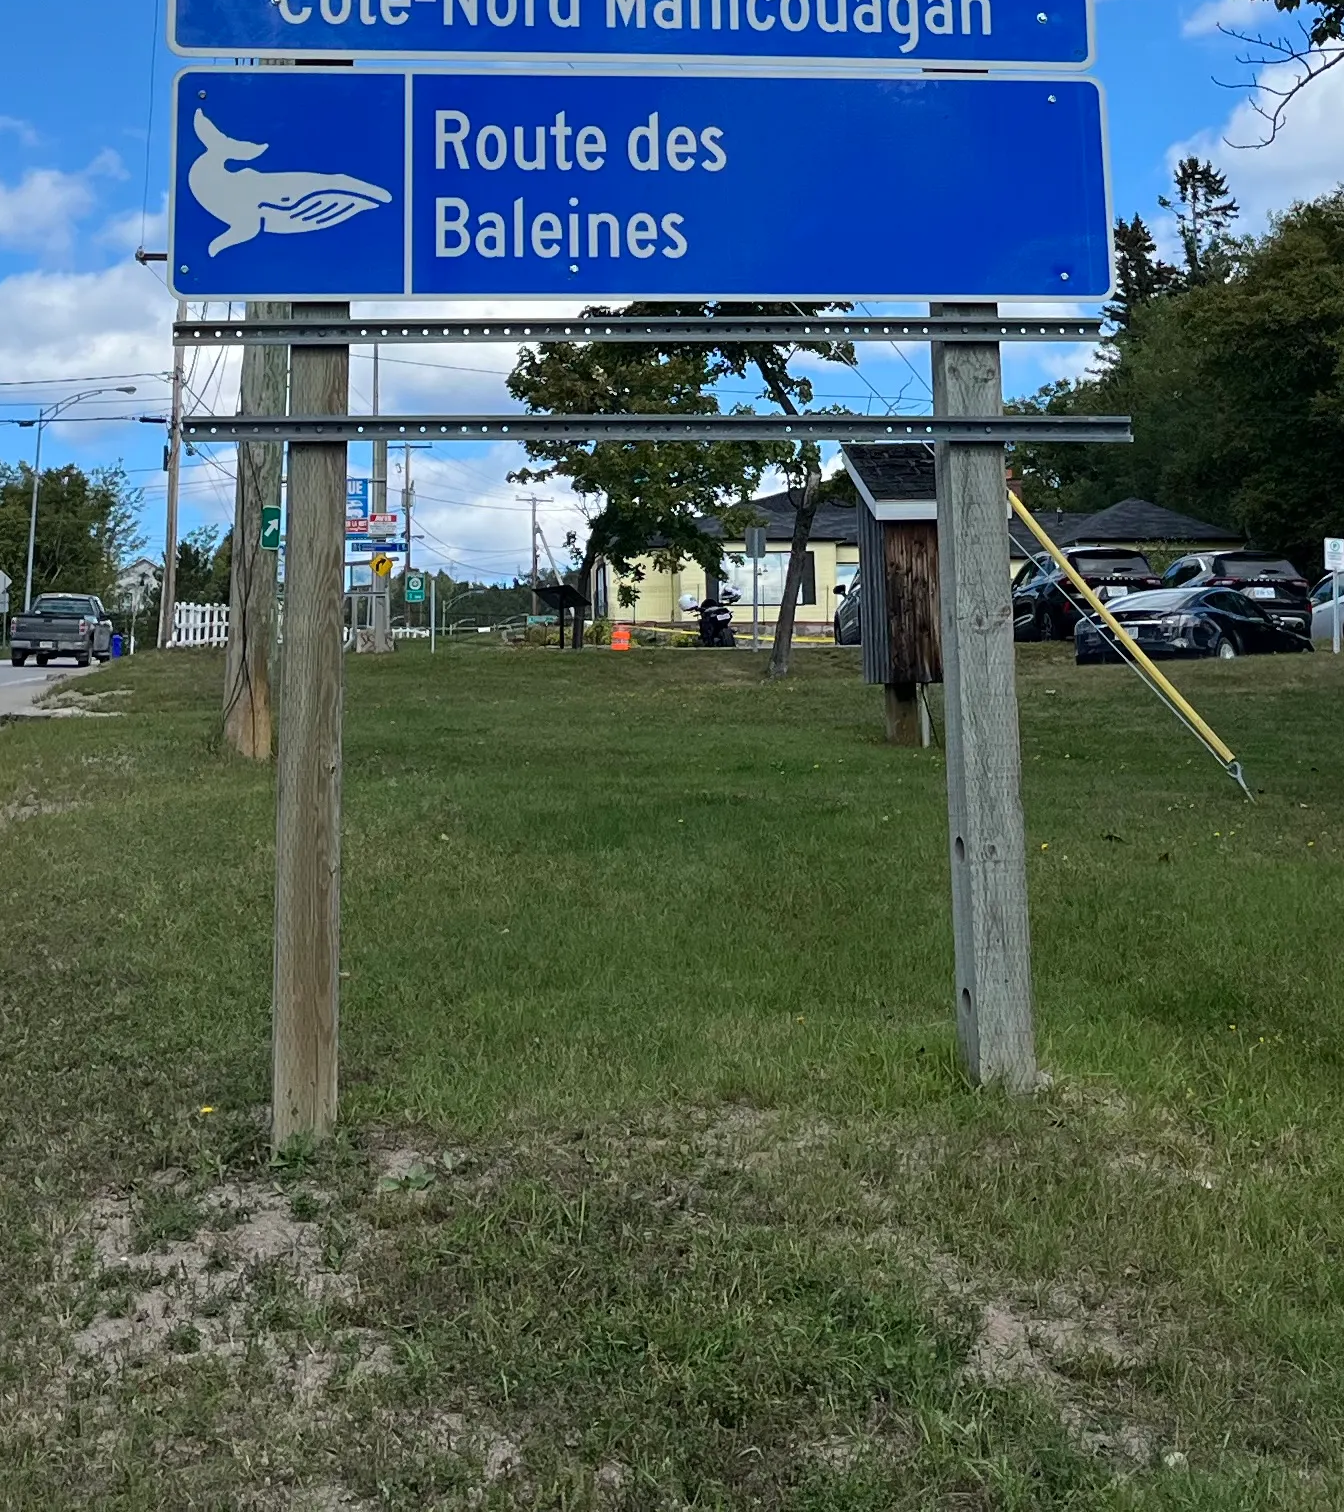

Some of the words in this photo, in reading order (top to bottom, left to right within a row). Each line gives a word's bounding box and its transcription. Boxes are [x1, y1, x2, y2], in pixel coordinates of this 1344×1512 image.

[435, 110, 607, 171] Route
[627, 111, 727, 172] des
[435, 197, 689, 259] Baleines
